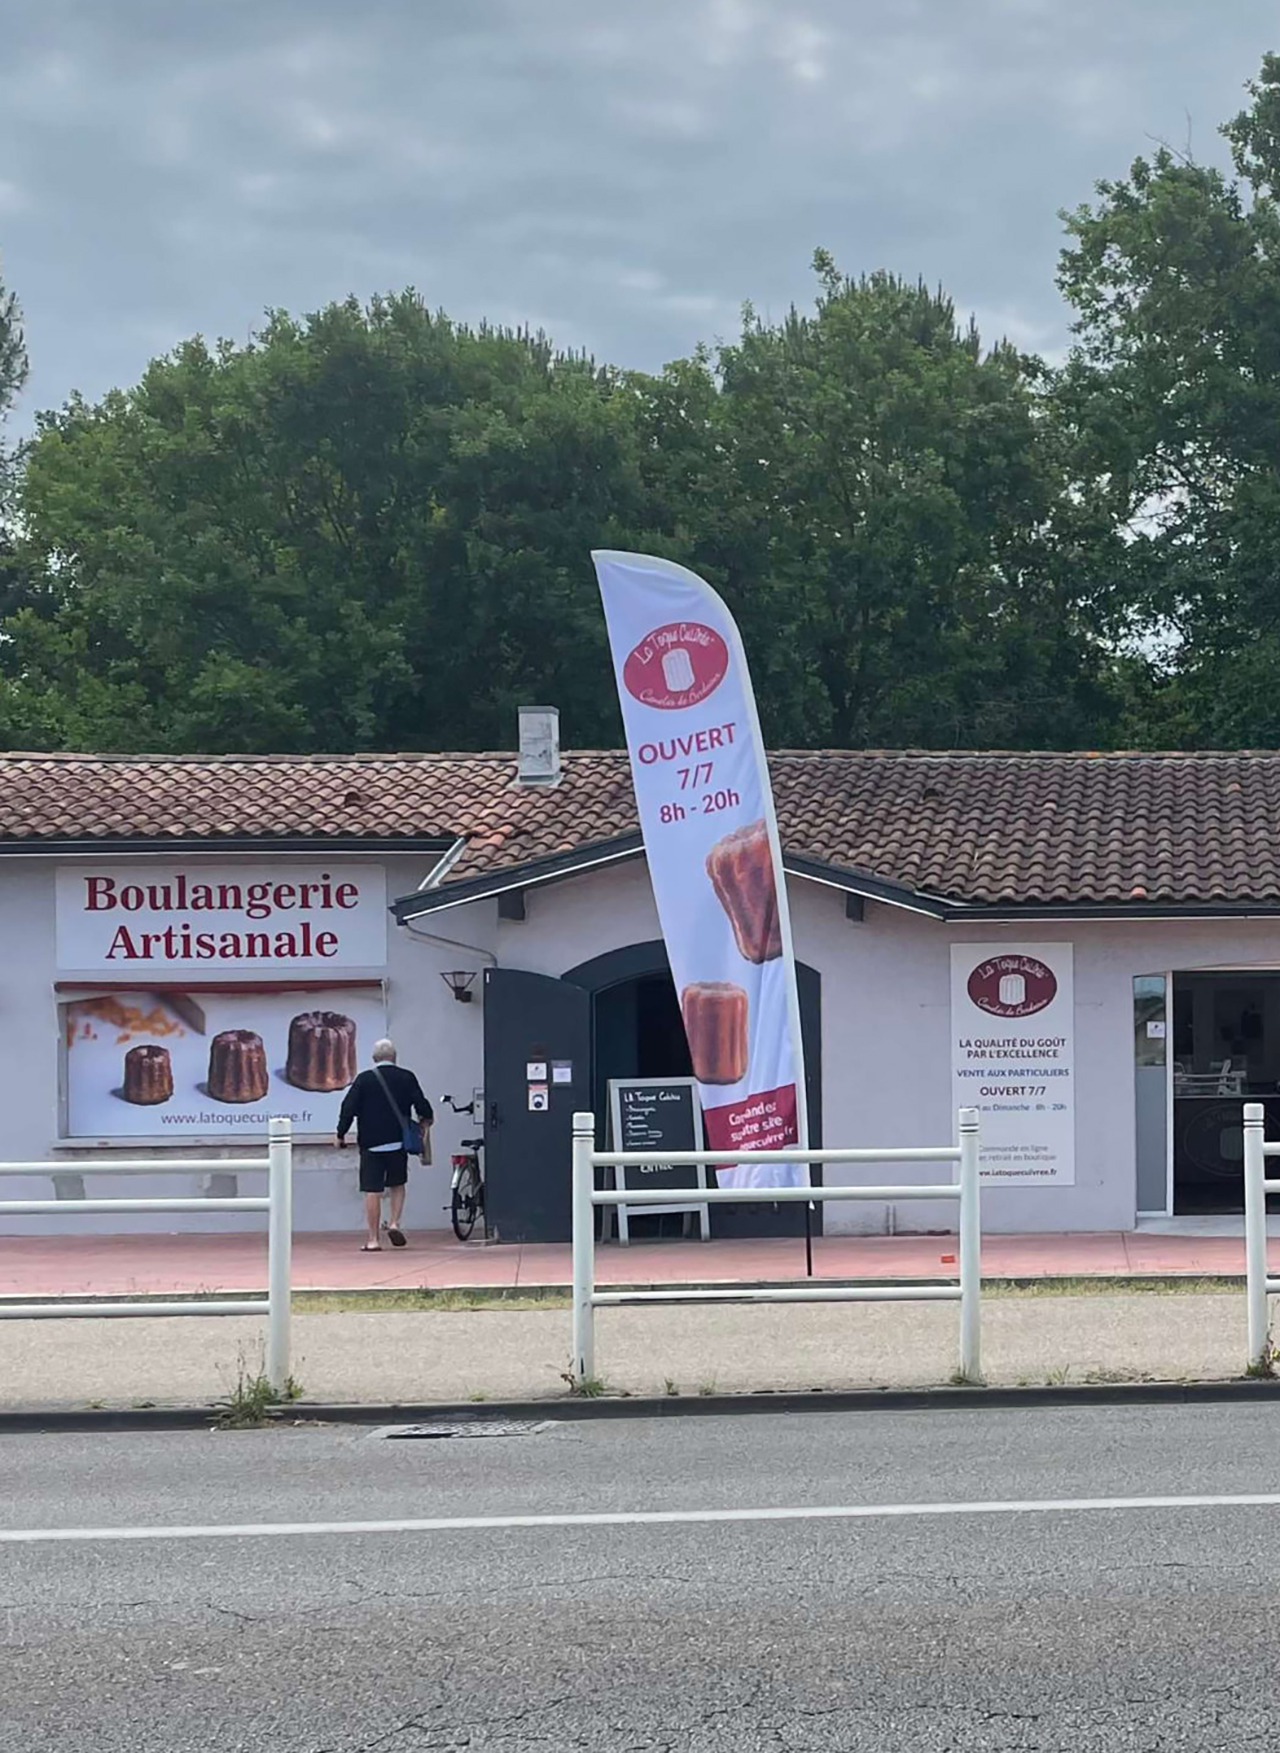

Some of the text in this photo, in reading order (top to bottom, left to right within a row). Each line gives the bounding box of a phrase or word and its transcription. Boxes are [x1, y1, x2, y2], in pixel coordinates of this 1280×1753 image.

[638, 722, 736, 765] OUVERT
[677, 762, 713, 790] 7/7
[660, 803, 686, 824] 8h
[702, 788, 740, 814] 20h
[84, 873, 360, 919] Boulangerie
[105, 922, 339, 960] Artisanale
[959, 1036, 1066, 1049] LA QUALITÉ DU GOÛT
[967, 1049, 1059, 1059] PAR L'EXCELLENCE
[957, 1068, 1070, 1078] VENTE AUX PARTICULIERS
[980, 1086, 1047, 1096] OUVERT 7/7
